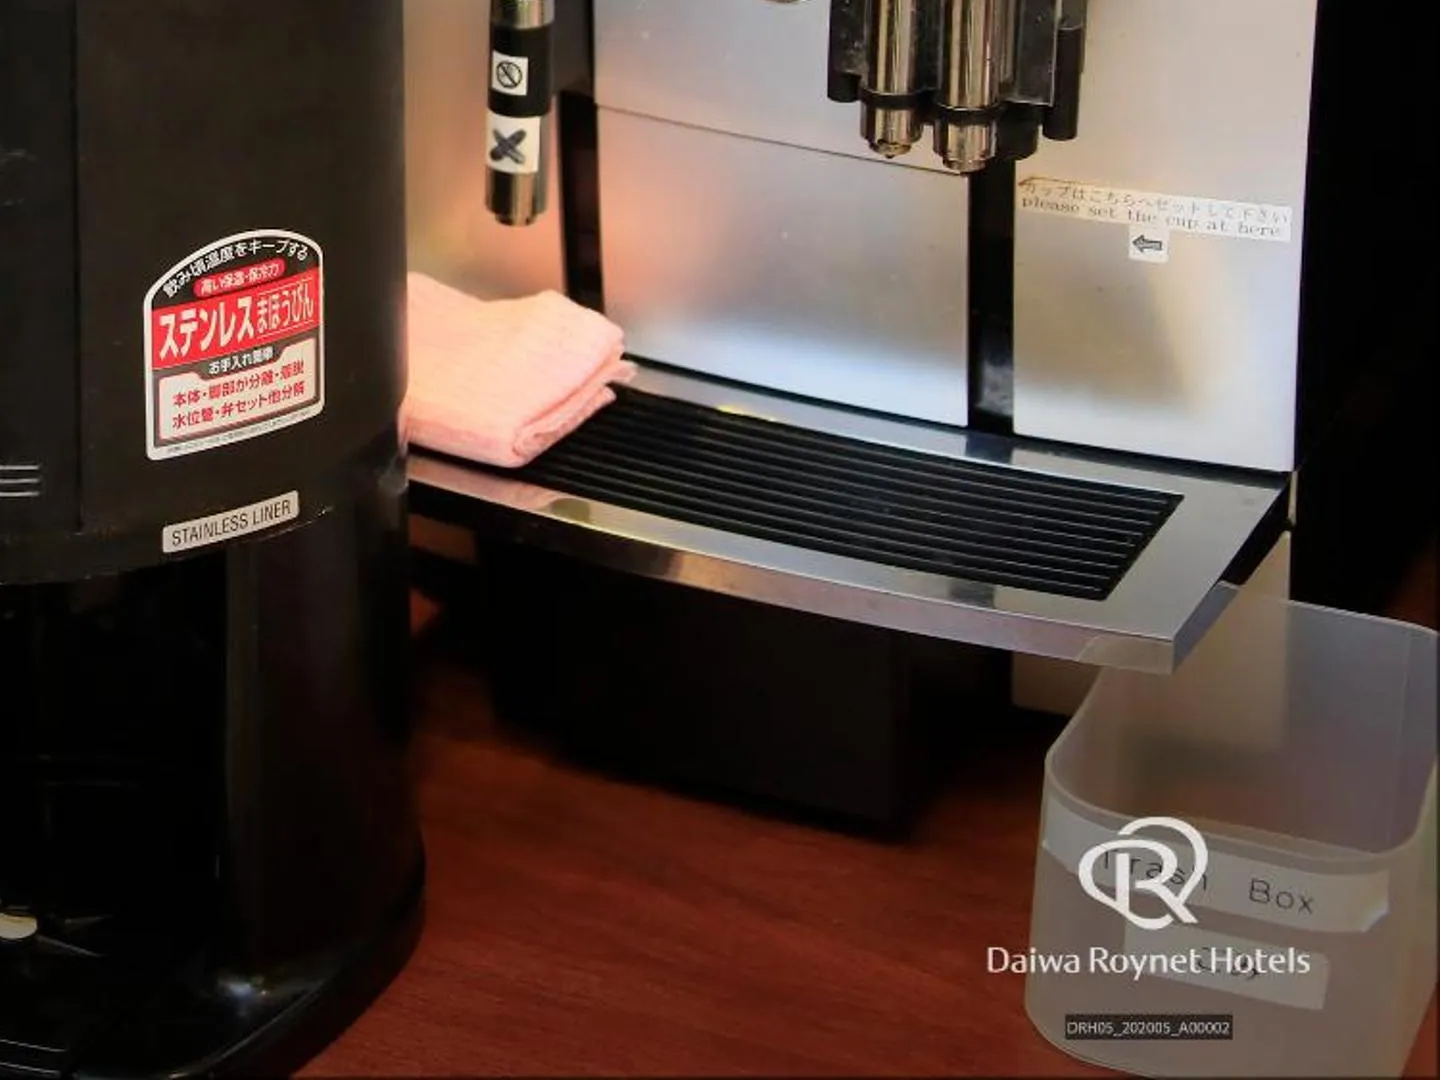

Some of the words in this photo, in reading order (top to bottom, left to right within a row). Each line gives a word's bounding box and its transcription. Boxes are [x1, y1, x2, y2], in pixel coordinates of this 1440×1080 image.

[1022, 196, 1080, 213] please
[1088, 205, 1118, 219] set
[1127, 208, 1159, 223] the
[1165, 214, 1199, 231] cup
[1206, 218, 1228, 232] at
[1238, 219, 1281, 236] here
[170, 512, 248, 547] STAINLESS
[251, 498, 293, 529] LINER
[1248, 877, 1315, 915] Box
